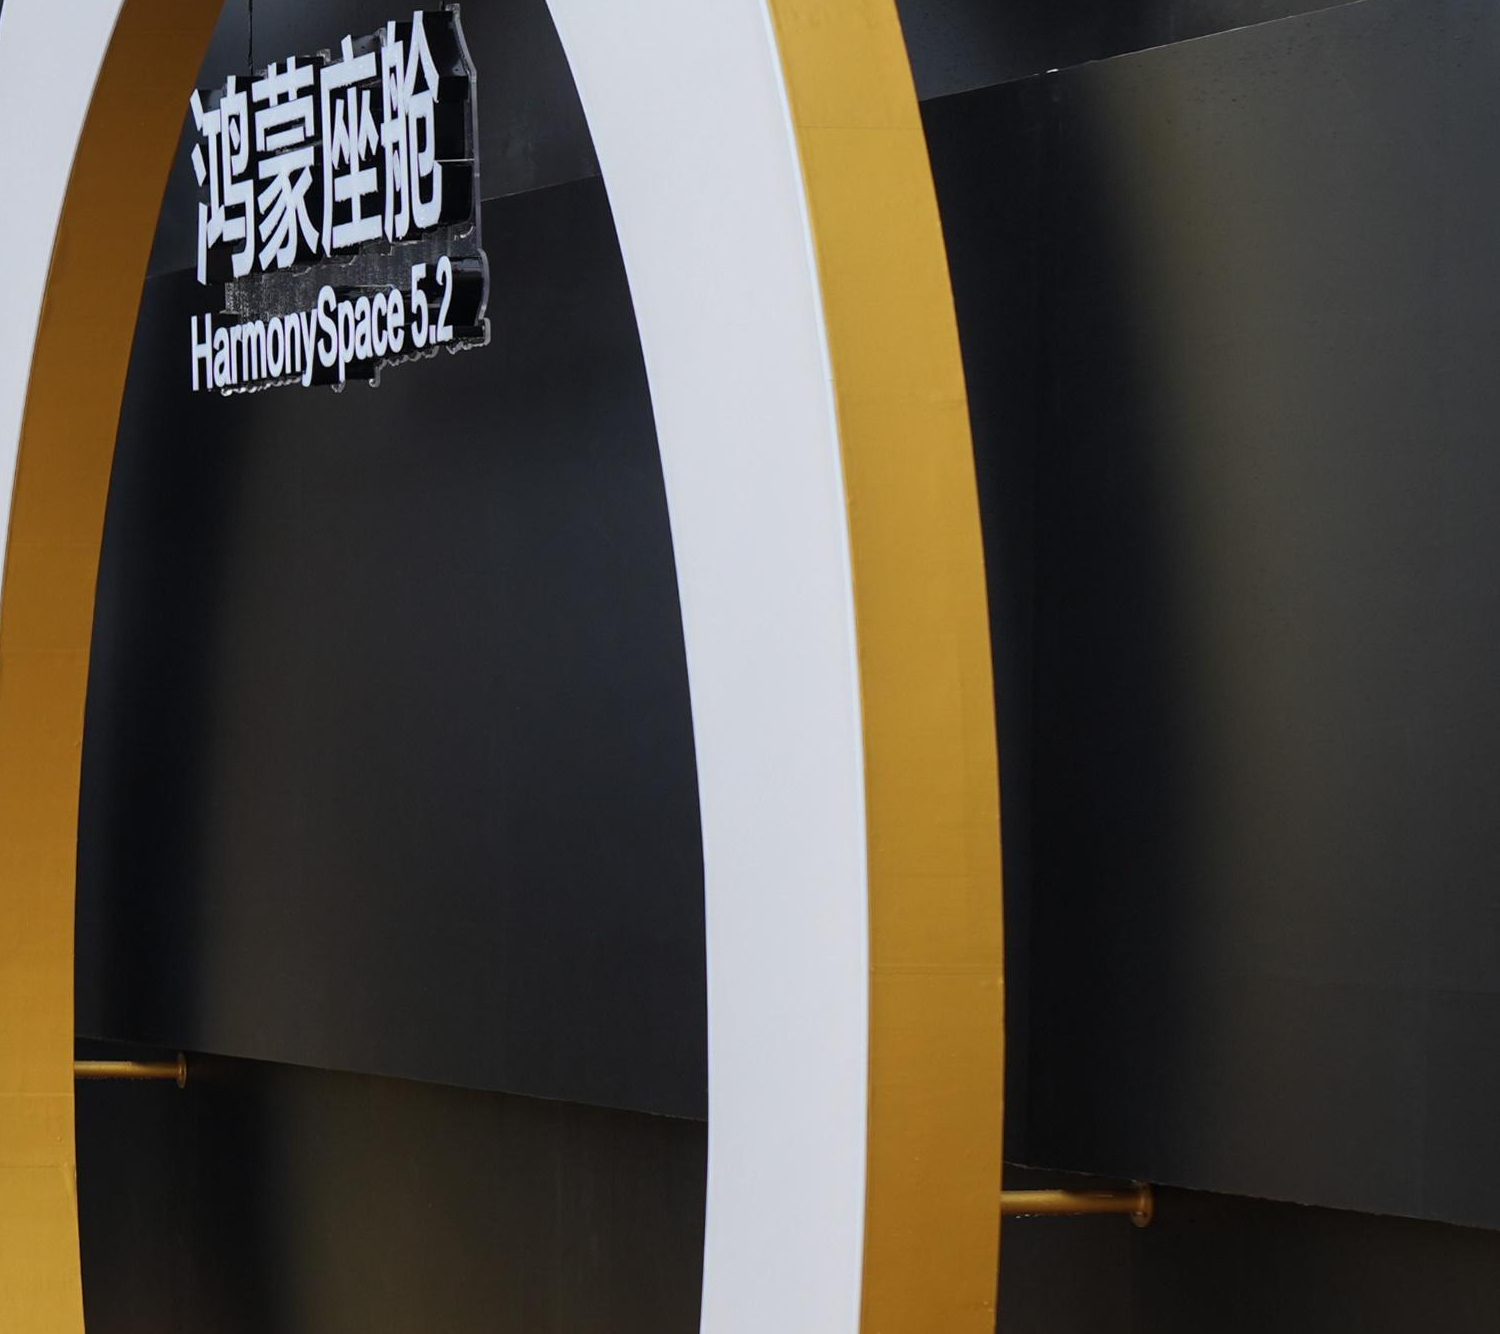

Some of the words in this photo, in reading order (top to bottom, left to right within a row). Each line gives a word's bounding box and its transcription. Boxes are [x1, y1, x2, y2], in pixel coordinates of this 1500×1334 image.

[190, 11, 442, 285] 鸿蒙座舱
[190, 285, 405, 391] HarmonySpace
[411, 255, 454, 348] 5.2
